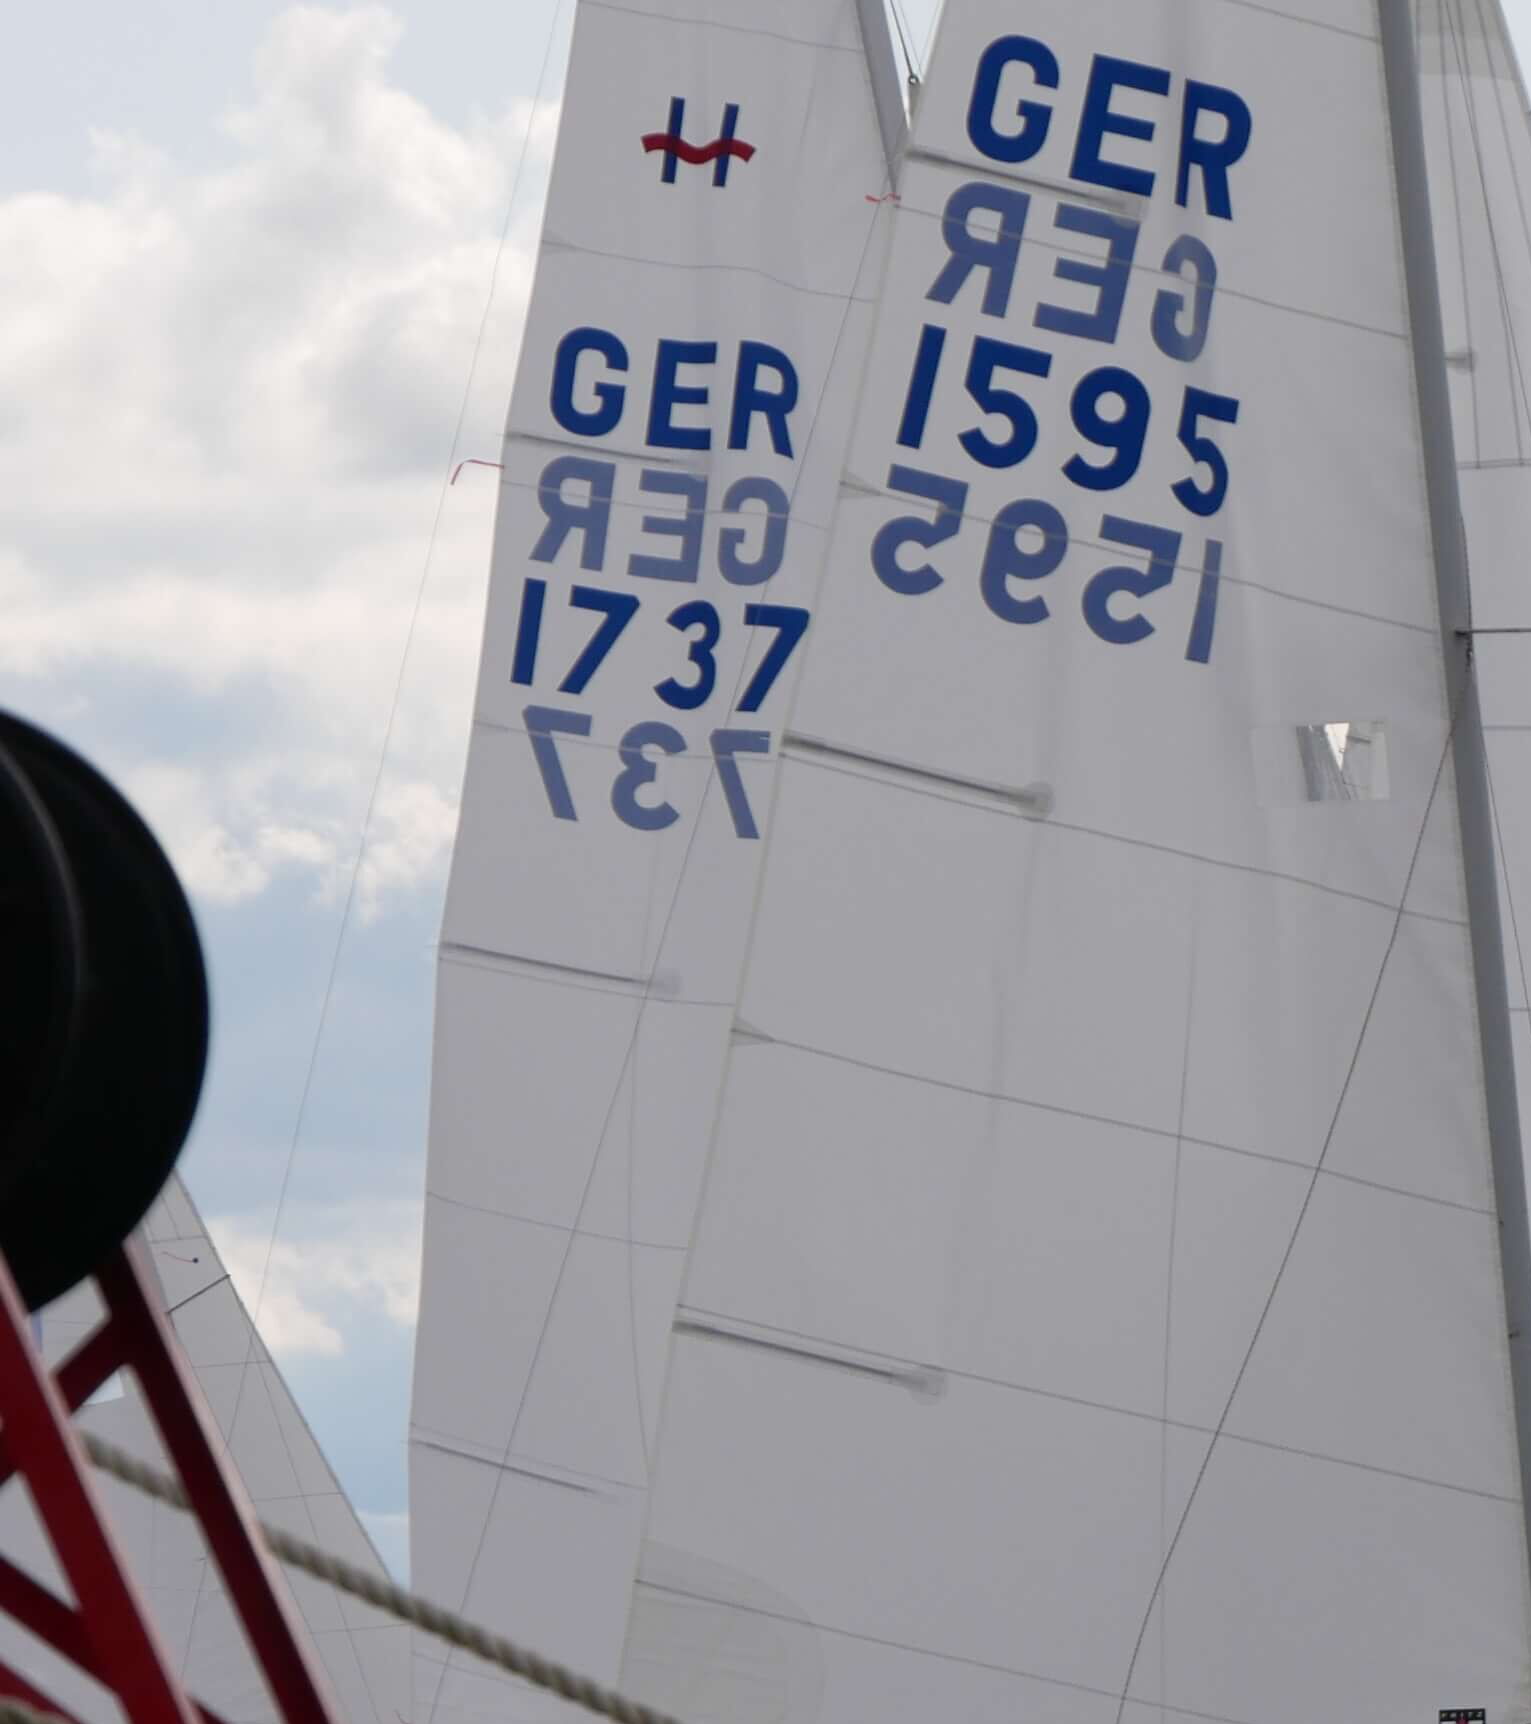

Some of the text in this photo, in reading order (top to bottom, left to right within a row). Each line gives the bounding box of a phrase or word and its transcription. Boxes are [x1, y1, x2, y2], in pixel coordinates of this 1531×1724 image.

[968, 36, 1251, 220] GER
[551, 328, 799, 459] GER
[897, 325, 1238, 517] 1595
[511, 578, 810, 712] 1737
